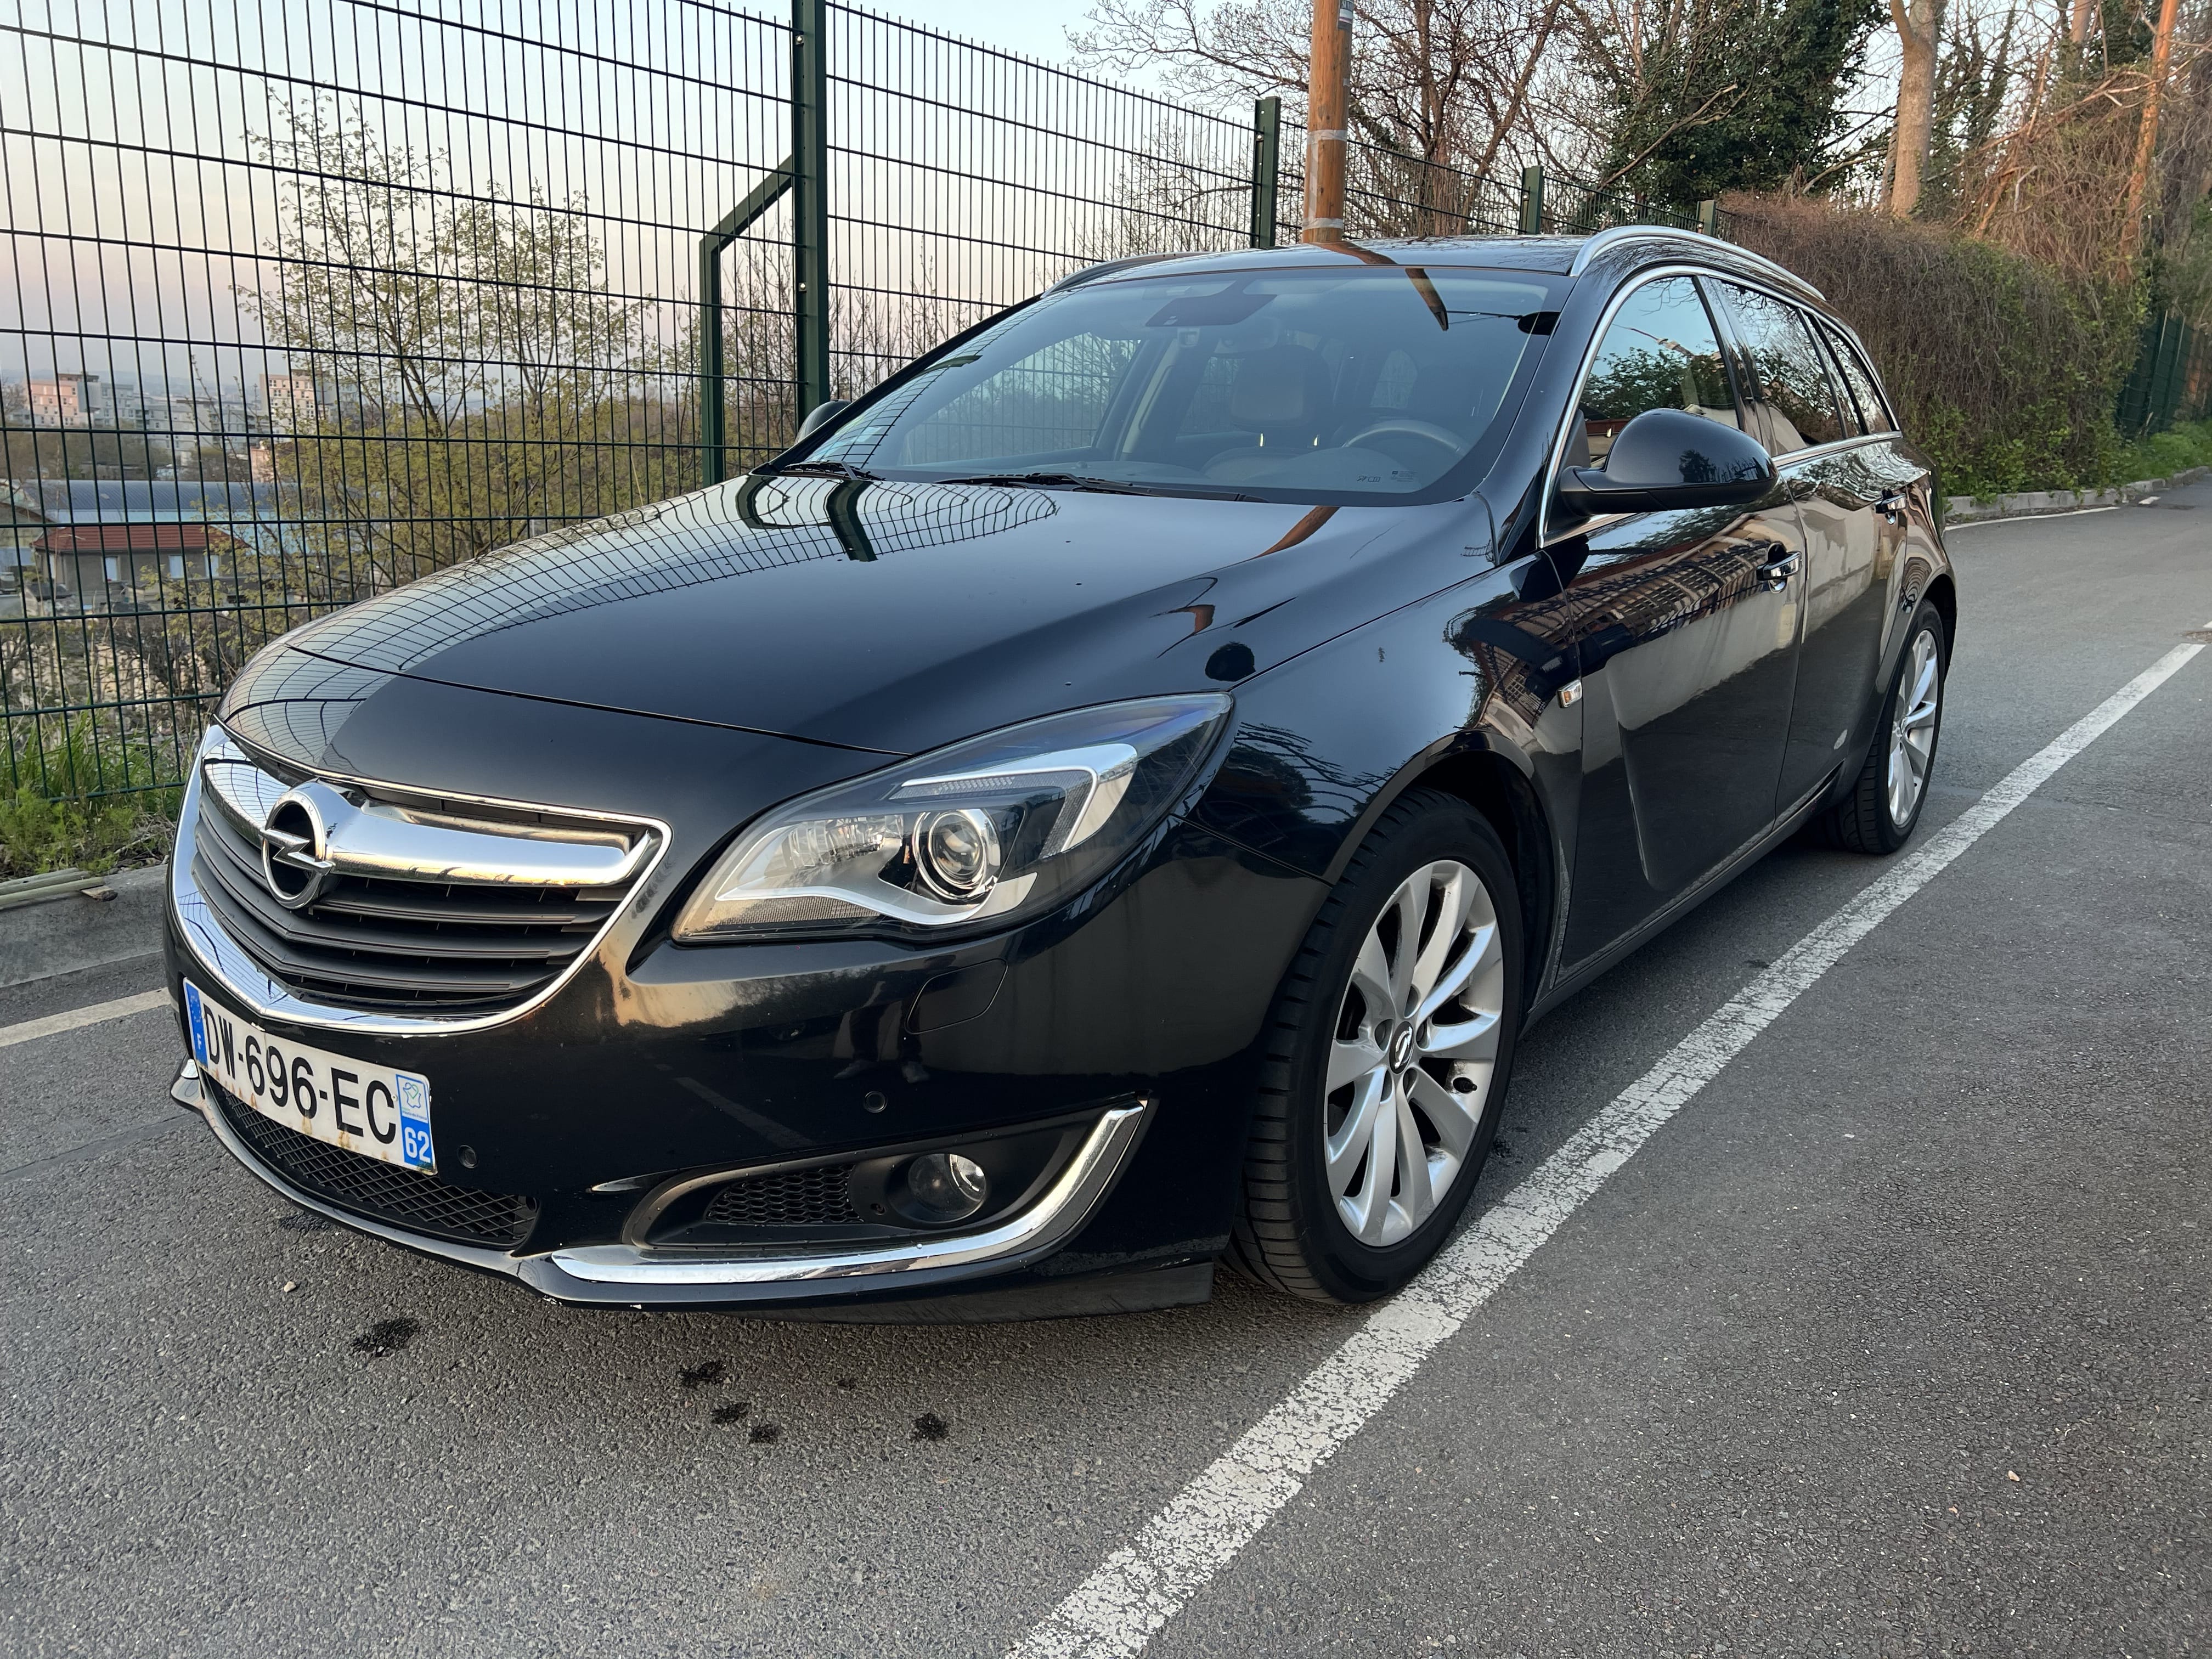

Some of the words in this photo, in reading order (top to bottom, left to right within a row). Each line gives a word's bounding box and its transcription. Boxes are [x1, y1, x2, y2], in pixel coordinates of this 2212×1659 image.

[196, 1032, 202, 1050] F
[204, 1003, 396, 1144] DW-696-EC
[404, 1126, 431, 1163] 62
